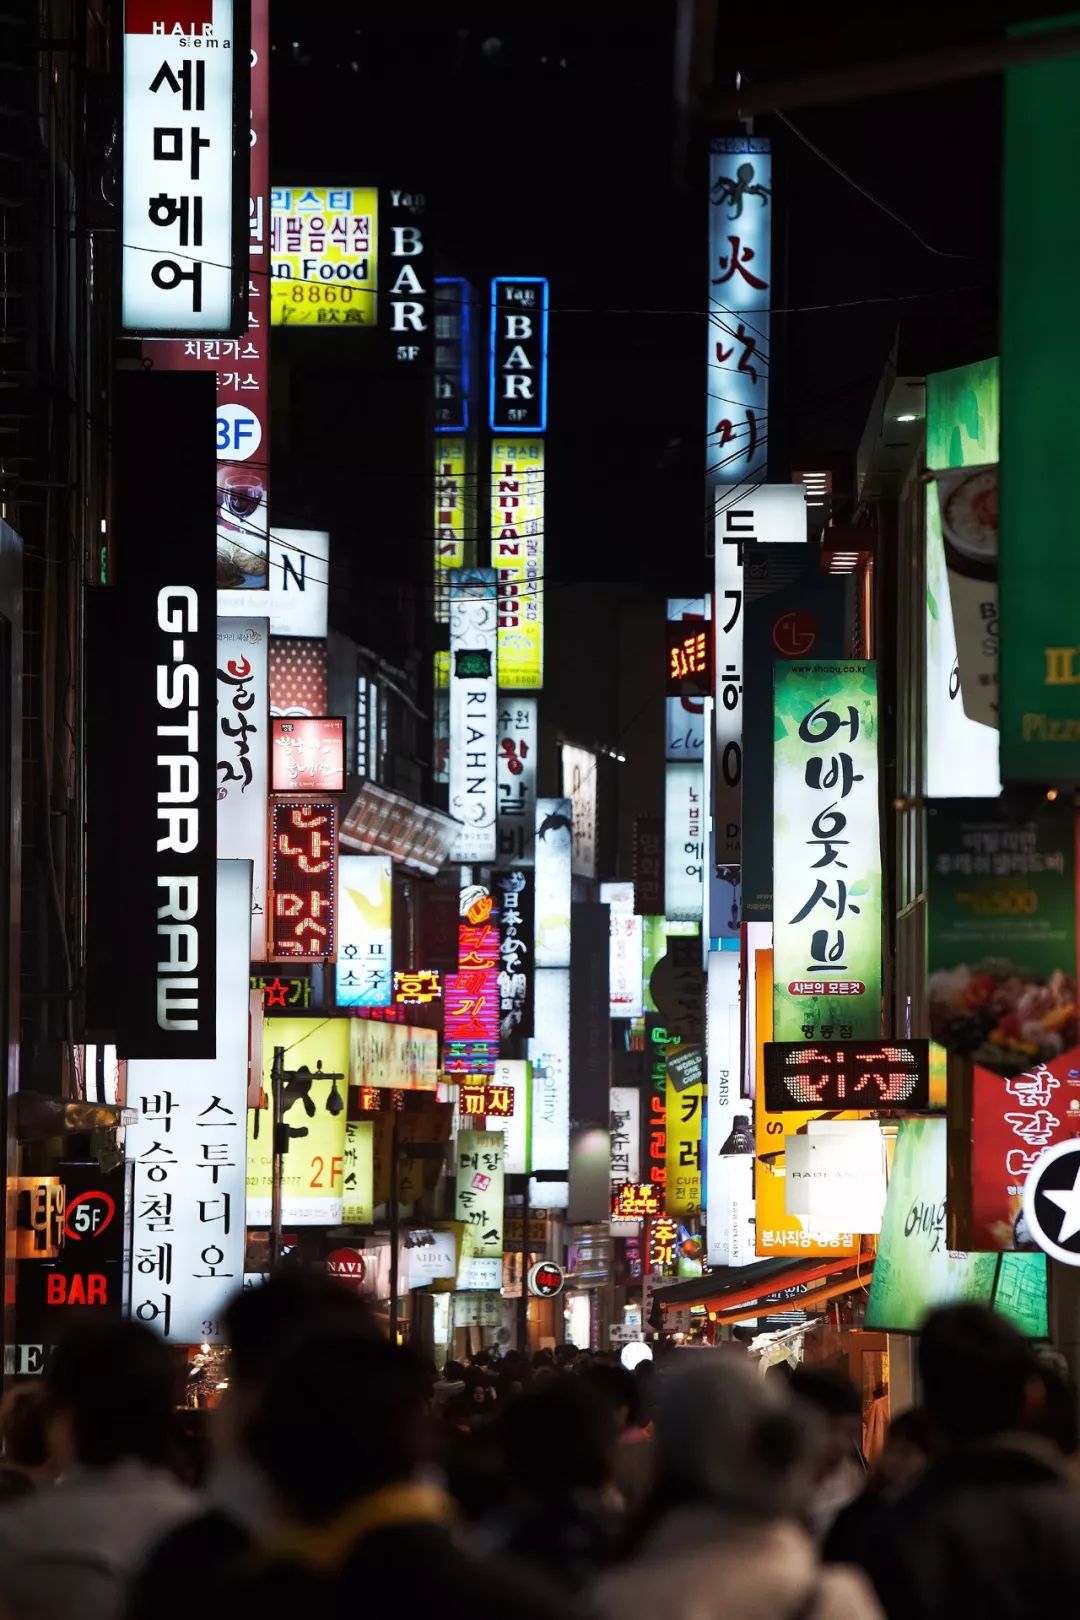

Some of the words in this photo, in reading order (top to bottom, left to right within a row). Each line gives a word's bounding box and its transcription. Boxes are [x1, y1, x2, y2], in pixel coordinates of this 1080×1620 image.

[152, 22, 213, 36] HAIR
[179, 38, 231, 49] sema
[148, 60, 210, 313] 세마헤어
[303, 259, 369, 280] Food
[390, 226, 427, 332] BAR
[184, 341, 260, 361] 치킨가스
[502, 315, 535, 400] BAR
[499, 464, 519, 556] INDIAN
[498, 568, 519, 628] FOOD
[157, 585, 199, 856] G-STAR
[466, 692, 487, 795] RIAHN
[157, 875, 199, 1031] RAW
[793, 981, 824, 993] 샤브의
[829, 981, 860, 994] 모든것
[801, 1024, 853, 1039] 명동점
[720, 1070, 729, 1106] PARIS
[193, 1096, 236, 1278] 스투디오
[310, 1155, 343, 1188] 2F
[74, 1204, 101, 1233] 5F
[136, 1091, 178, 1336] 박승철헤어
[328, 1262, 362, 1273] NAVI
[47, 1274, 107, 1304] BAR
